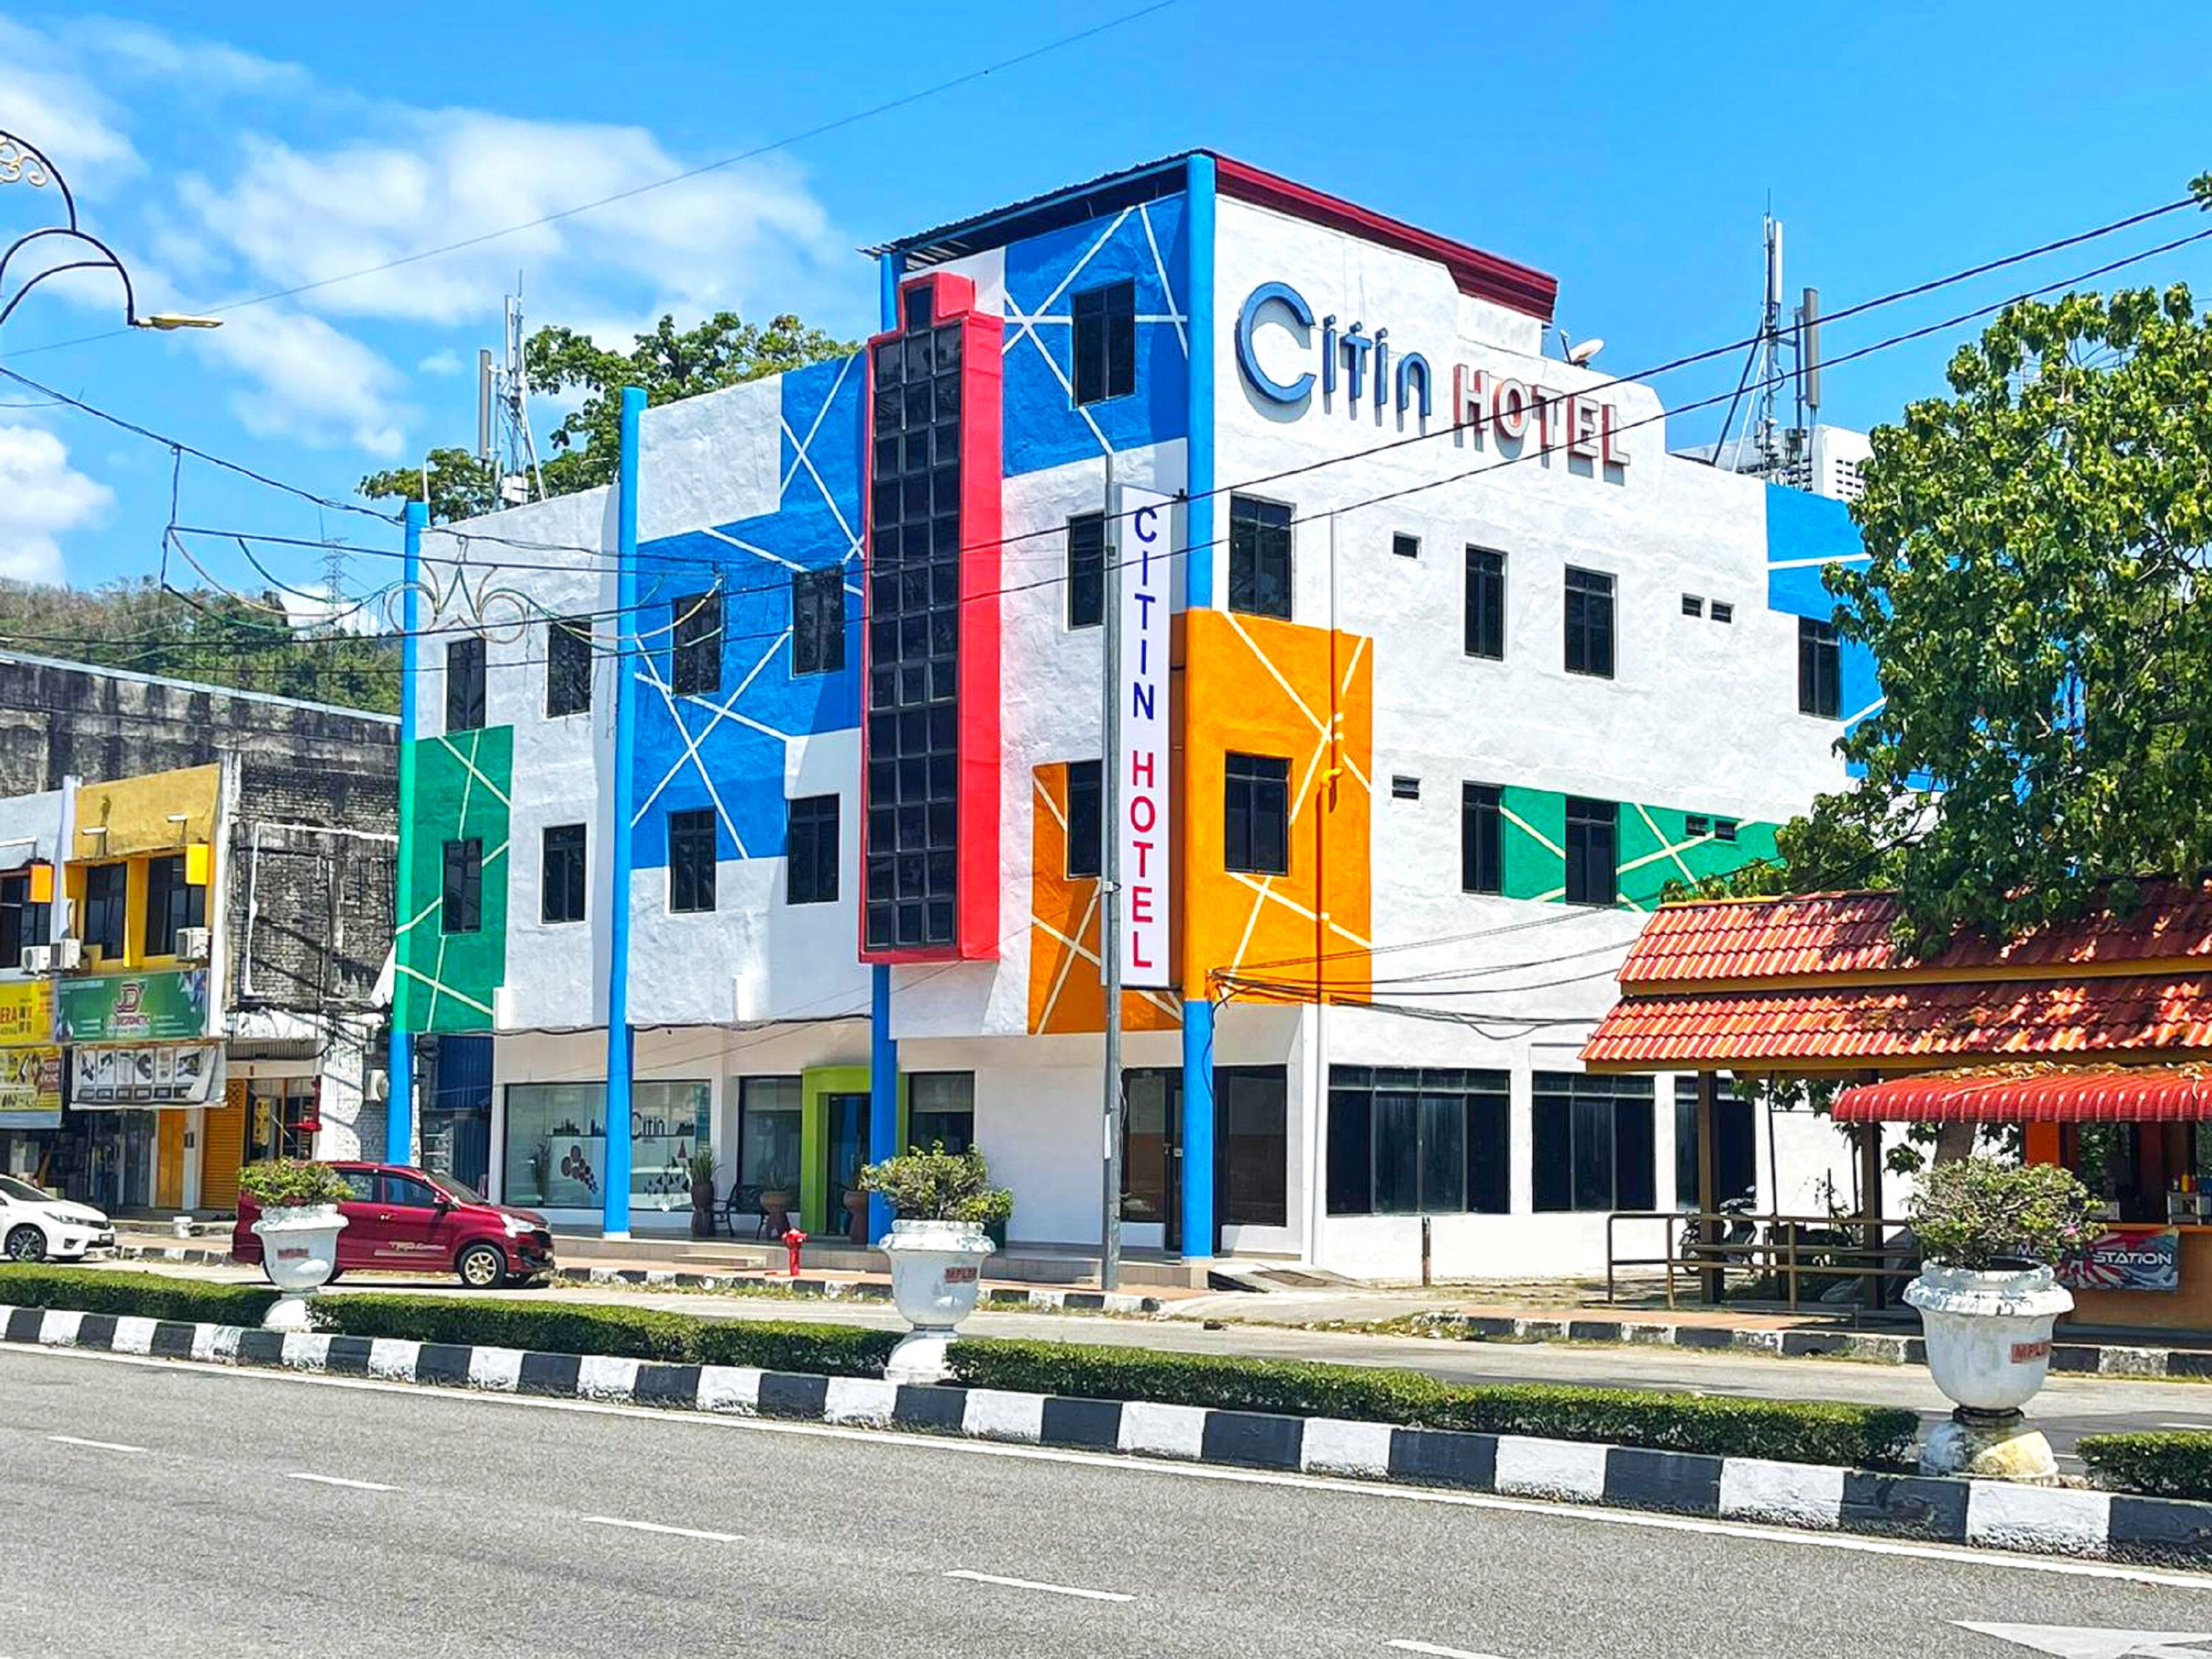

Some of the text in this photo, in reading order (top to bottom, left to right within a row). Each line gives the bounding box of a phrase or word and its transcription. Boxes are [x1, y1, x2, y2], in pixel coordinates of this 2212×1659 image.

[1453, 364, 1630, 466] HOTEL
[1130, 506, 1157, 968] CITIN HOTEL
[2093, 1251, 2172, 1265] STATION
